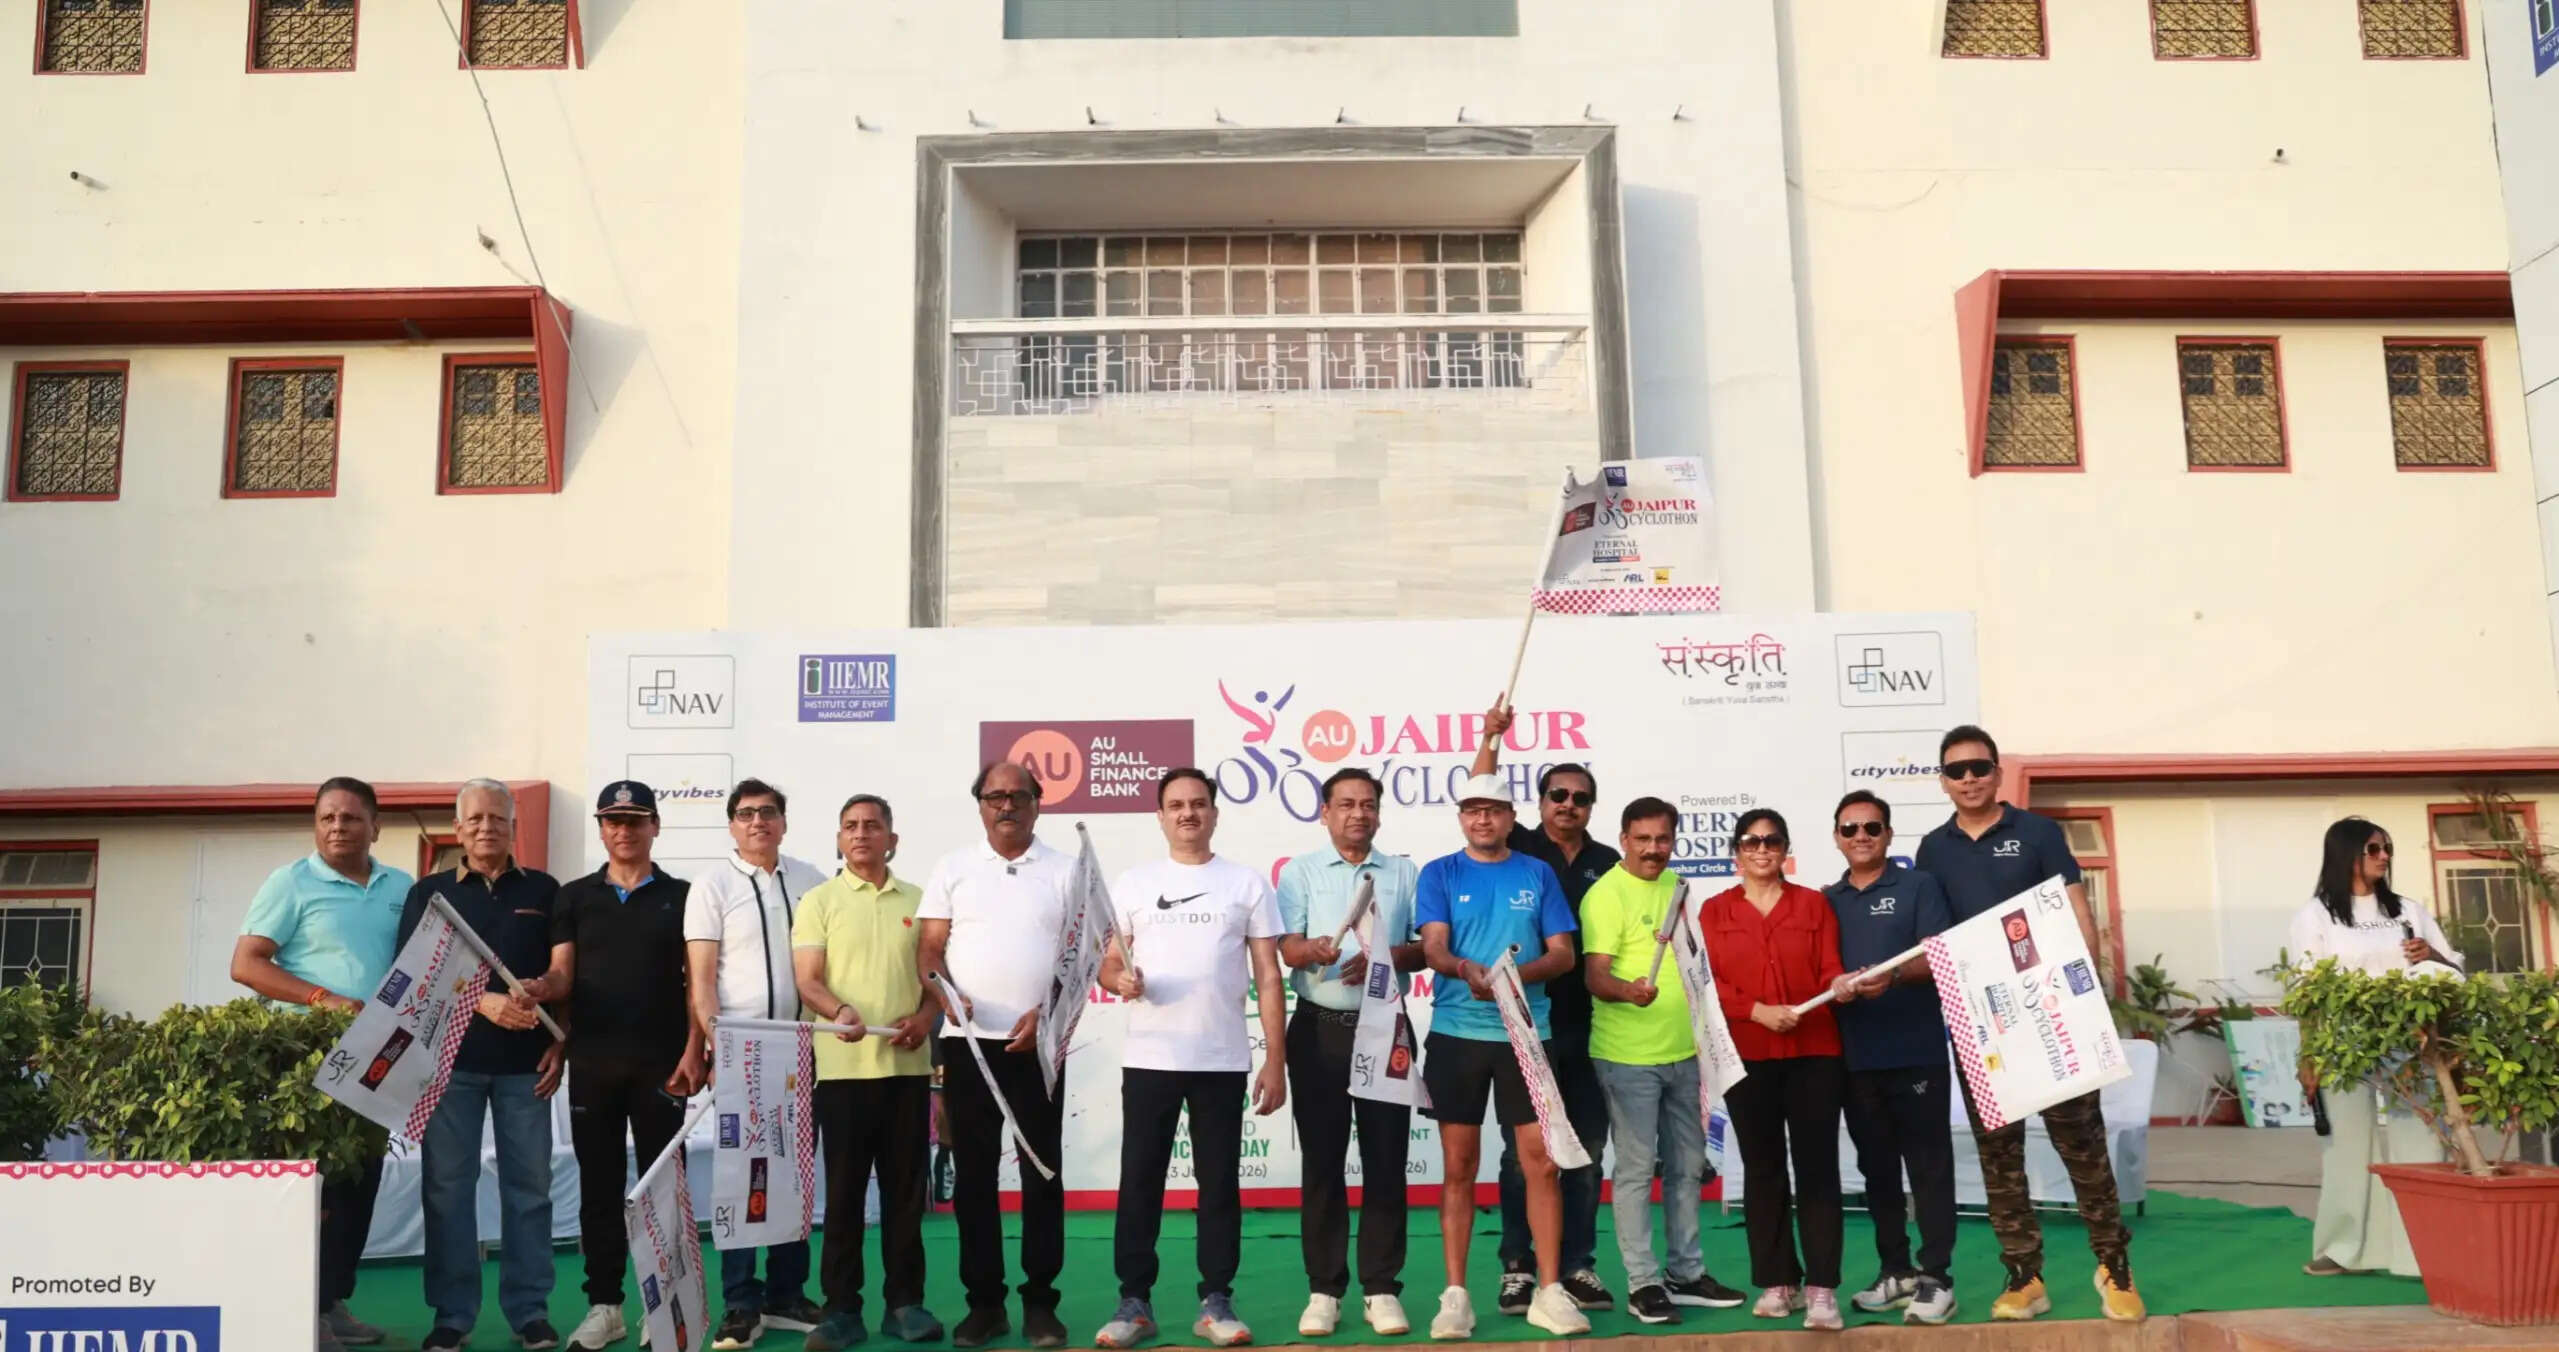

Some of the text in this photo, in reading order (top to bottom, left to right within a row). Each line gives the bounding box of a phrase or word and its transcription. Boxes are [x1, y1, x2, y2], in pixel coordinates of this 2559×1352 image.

[1636, 499, 1696, 511] JAIPUR
[1629, 513, 1698, 526] CYCLOTHON
[828, 661, 890, 689] IIEMR
[1879, 670, 1933, 692] NAV
[669, 693, 724, 715] NAV
[804, 700, 889, 709] INSTITUTE OF EVENT
[1307, 724, 1350, 748] AU
[1090, 737, 1116, 750] AU
[1090, 752, 1149, 766] SMALL
[1090, 783, 1141, 797] BANK
[1680, 793, 1757, 807] Powered By
[1699, 864, 1727, 873] Circle
[12, 1276, 155, 1296] Promoted By
